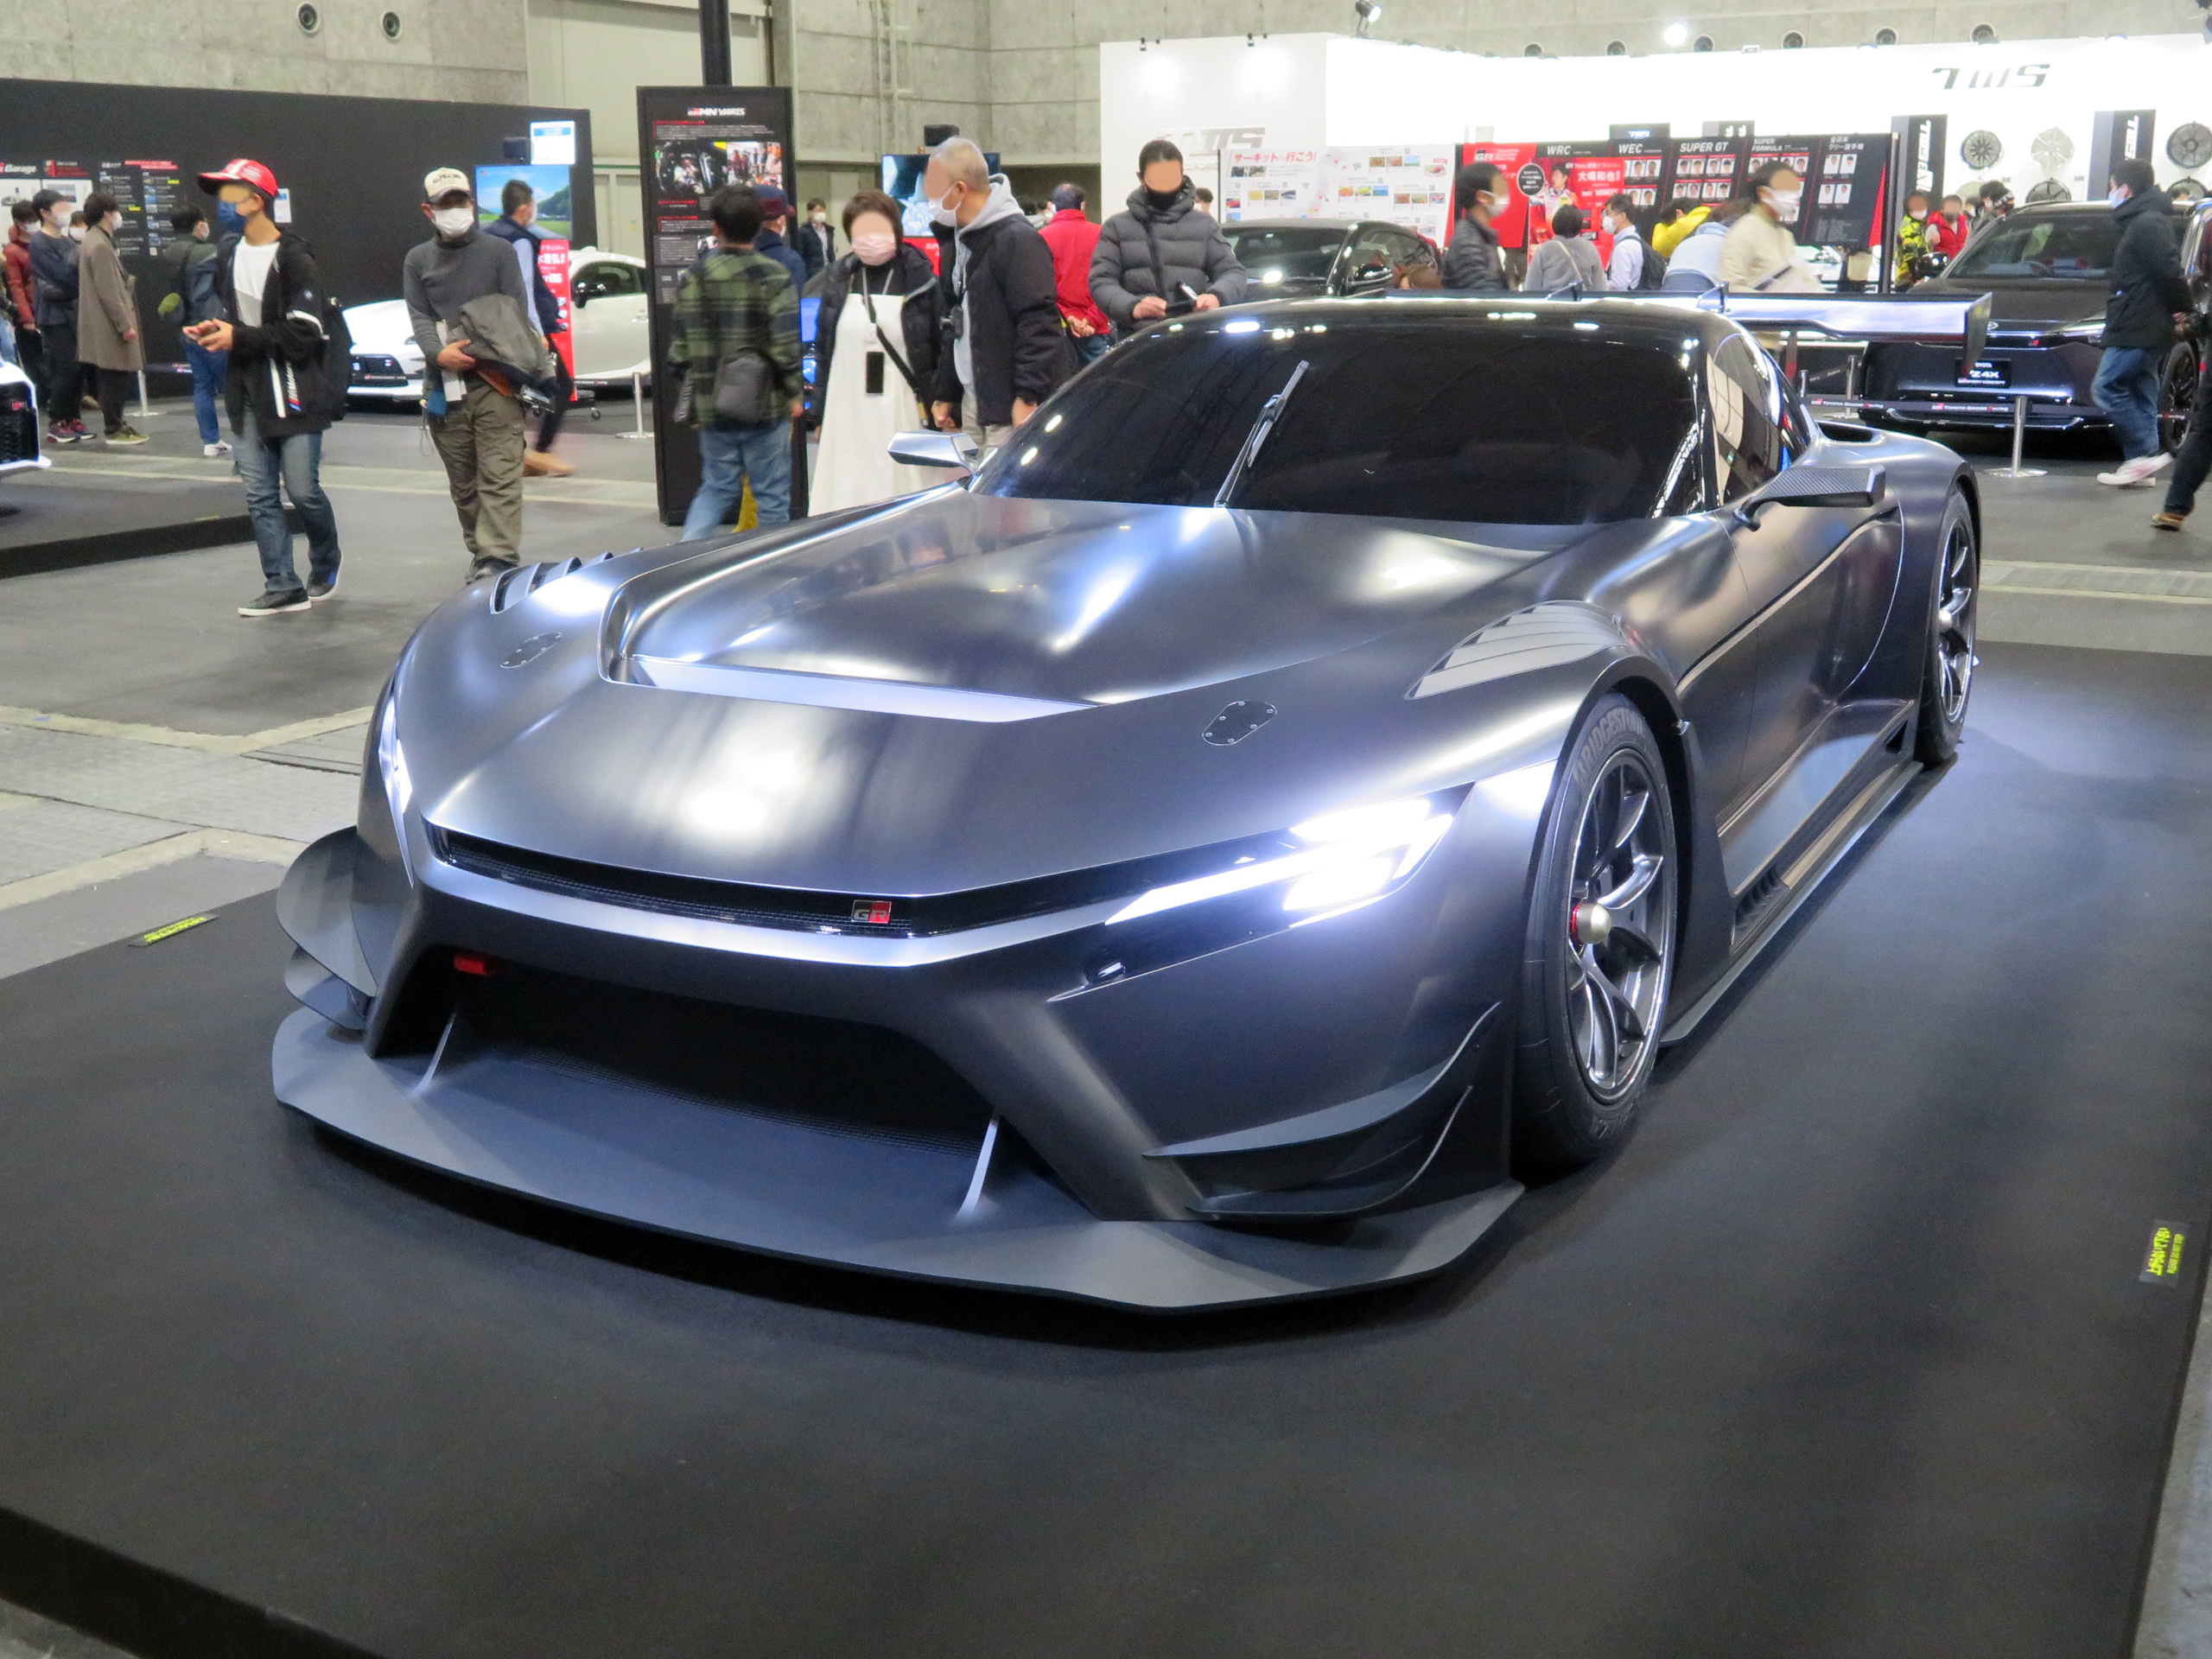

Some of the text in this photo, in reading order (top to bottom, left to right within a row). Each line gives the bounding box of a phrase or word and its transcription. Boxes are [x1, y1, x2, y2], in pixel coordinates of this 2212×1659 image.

[1932, 64, 2050, 90] TWS
[1547, 145, 1572, 156] WRC
[1618, 143, 1643, 154] WEC
[1680, 142, 1729, 153] SUPER GT
[1969, 370, 2000, 378] Z4X
